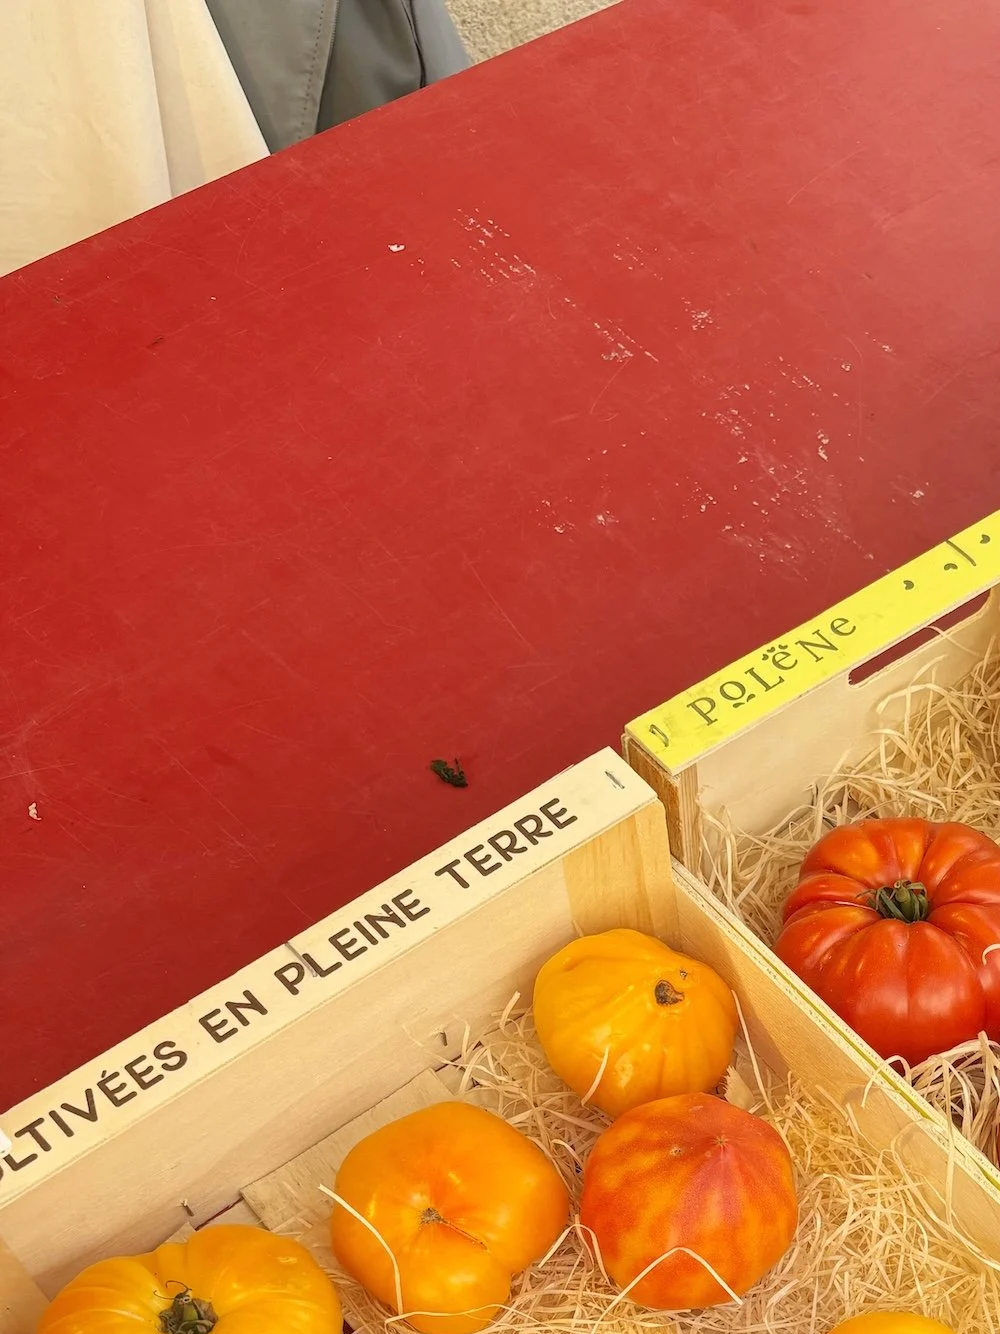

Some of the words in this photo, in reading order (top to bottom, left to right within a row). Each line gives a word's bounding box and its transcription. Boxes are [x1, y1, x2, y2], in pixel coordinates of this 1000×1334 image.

[199, 990, 268, 1044] EN
[273, 889, 431, 996] PLEINE
[434, 797, 578, 889] TERRE
